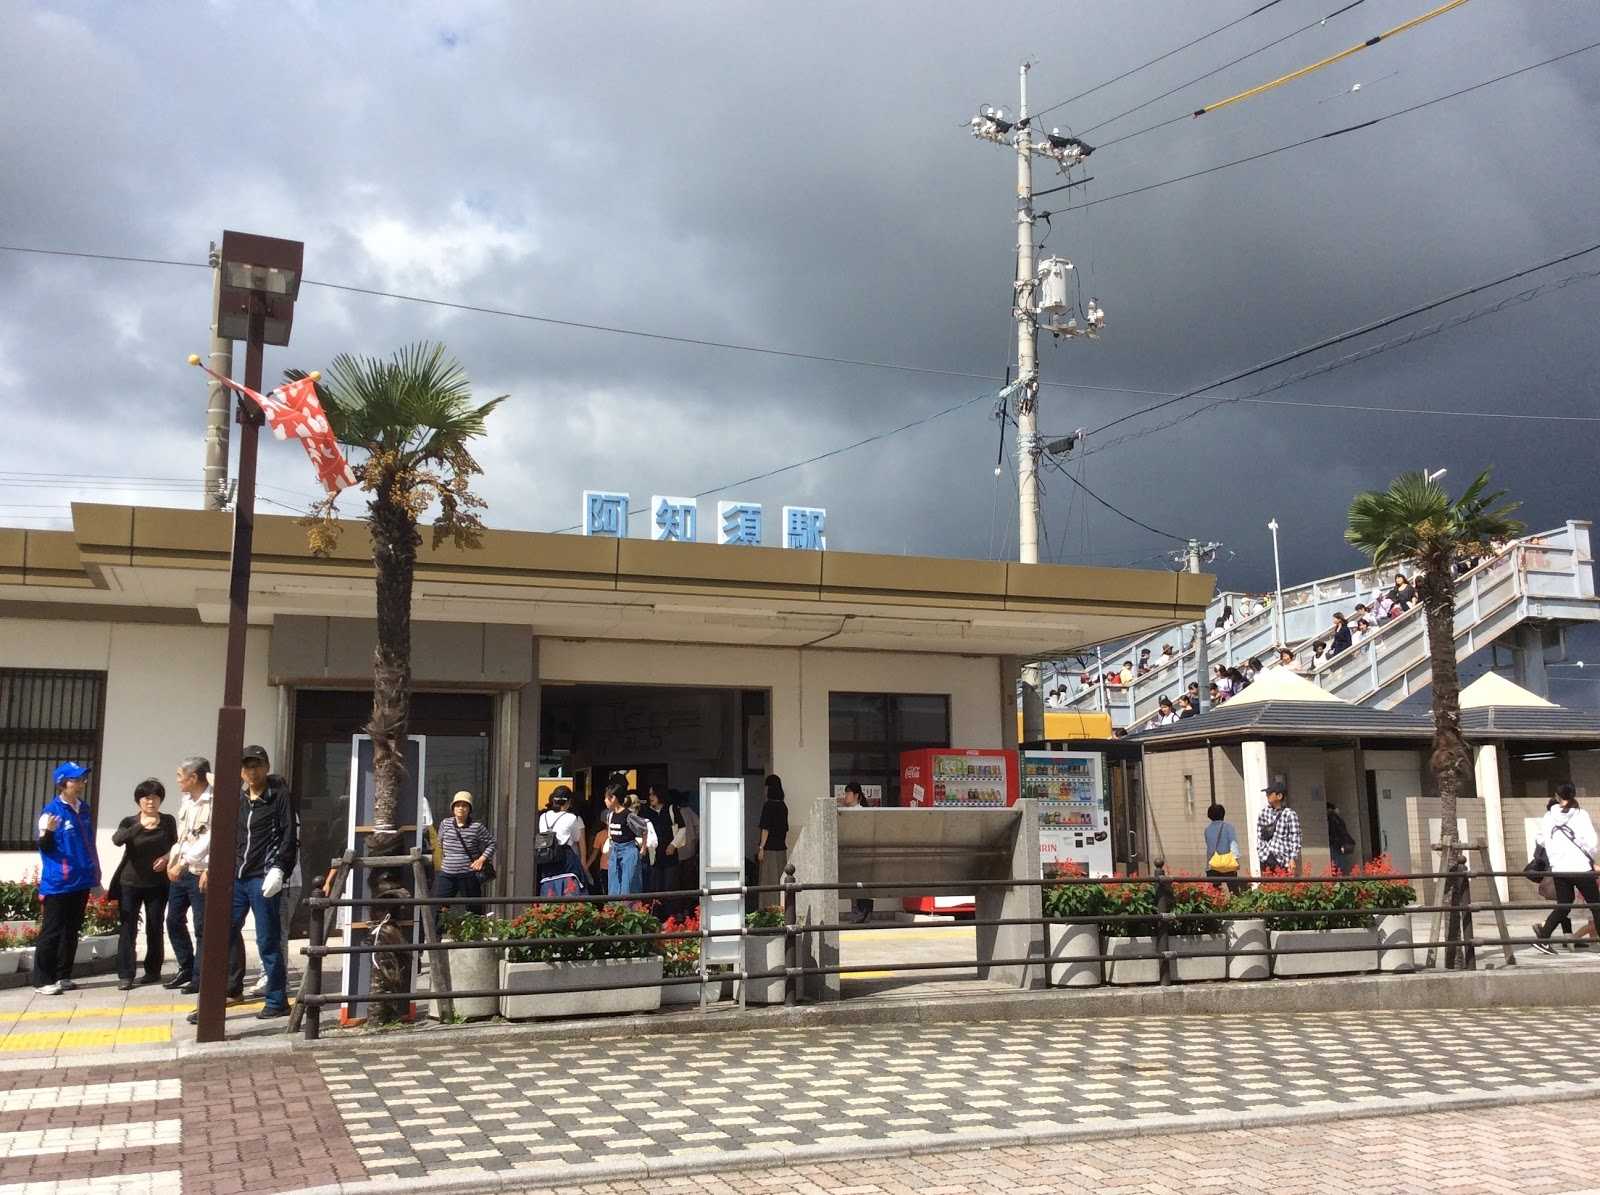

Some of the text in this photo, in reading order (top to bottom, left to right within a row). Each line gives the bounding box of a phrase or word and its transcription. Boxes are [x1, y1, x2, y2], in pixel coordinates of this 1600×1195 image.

[585, 492, 826, 552] 阿知須駅
[1039, 843, 1057, 853] IRIN
